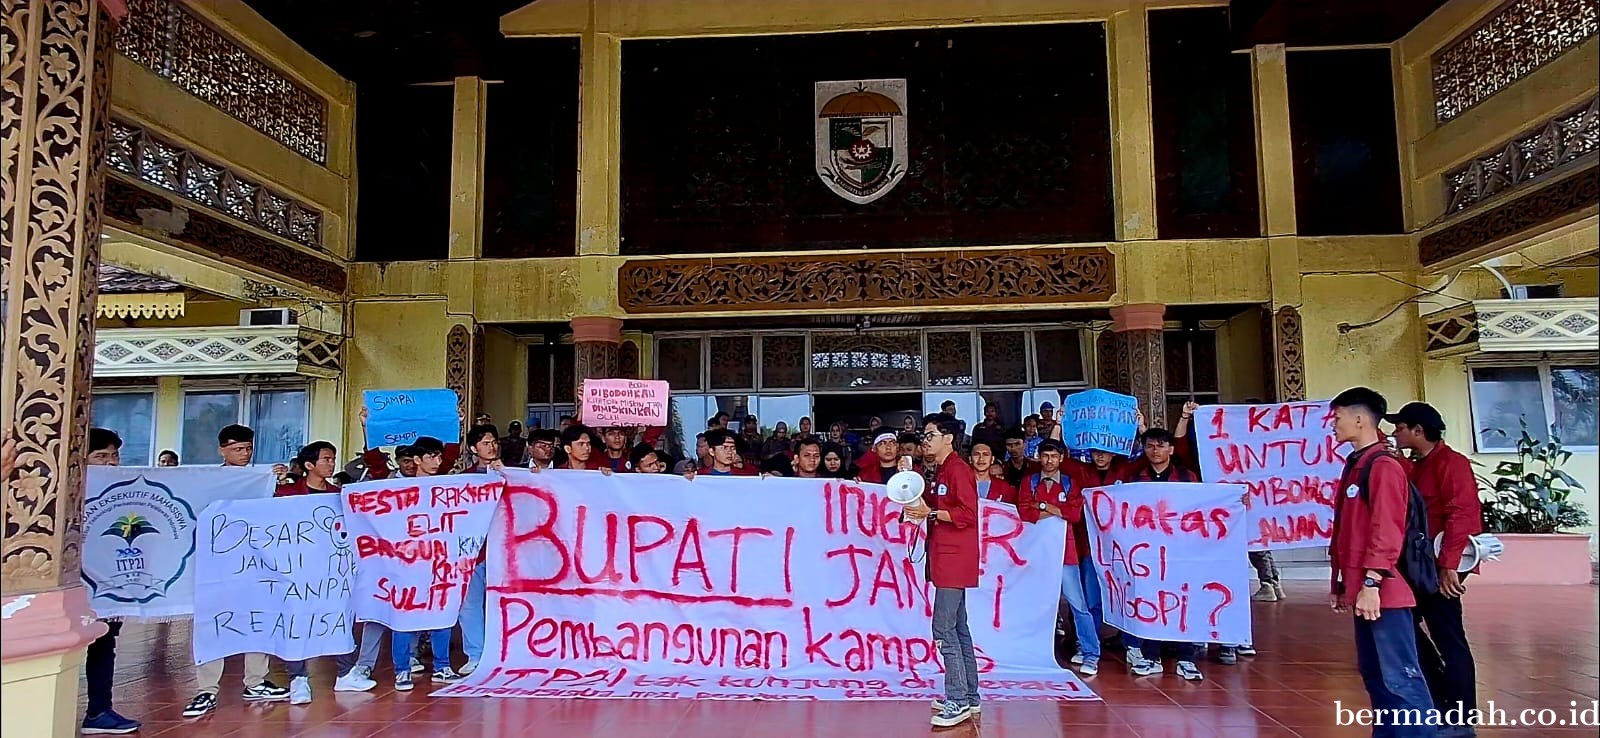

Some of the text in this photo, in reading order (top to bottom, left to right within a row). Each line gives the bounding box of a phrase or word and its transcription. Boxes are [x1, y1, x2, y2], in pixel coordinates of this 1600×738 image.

[373, 394, 417, 411] SAMPAI
[591, 389, 655, 398] DIBODOHKAN
[592, 405, 660, 417] DIMISKINKAN
[1208, 408, 1230, 439] 1
[384, 430, 418, 445] SEMPIT
[1216, 435, 1347, 475] UNTUK
[100, 491, 149, 508] EKSEKUTIF
[150, 493, 188, 531] MAHASISWA
[348, 481, 503, 516] PESTA RAKYAT
[212, 513, 316, 557] BESAR
[407, 510, 469, 538] ELIT
[502, 484, 796, 593] BUPATI
[823, 481, 1028, 566] INGR
[232, 552, 303, 575] JANJI
[1097, 535, 1166, 581] LAGI
[258, 577, 352, 602] TANPA
[825, 543, 1004, 629] JANI
[214, 611, 352, 639] REALISA
[500, 596, 788, 670] Pembangunan
[634, 674, 707, 687] tak
[718, 675, 889, 690] kunjung
